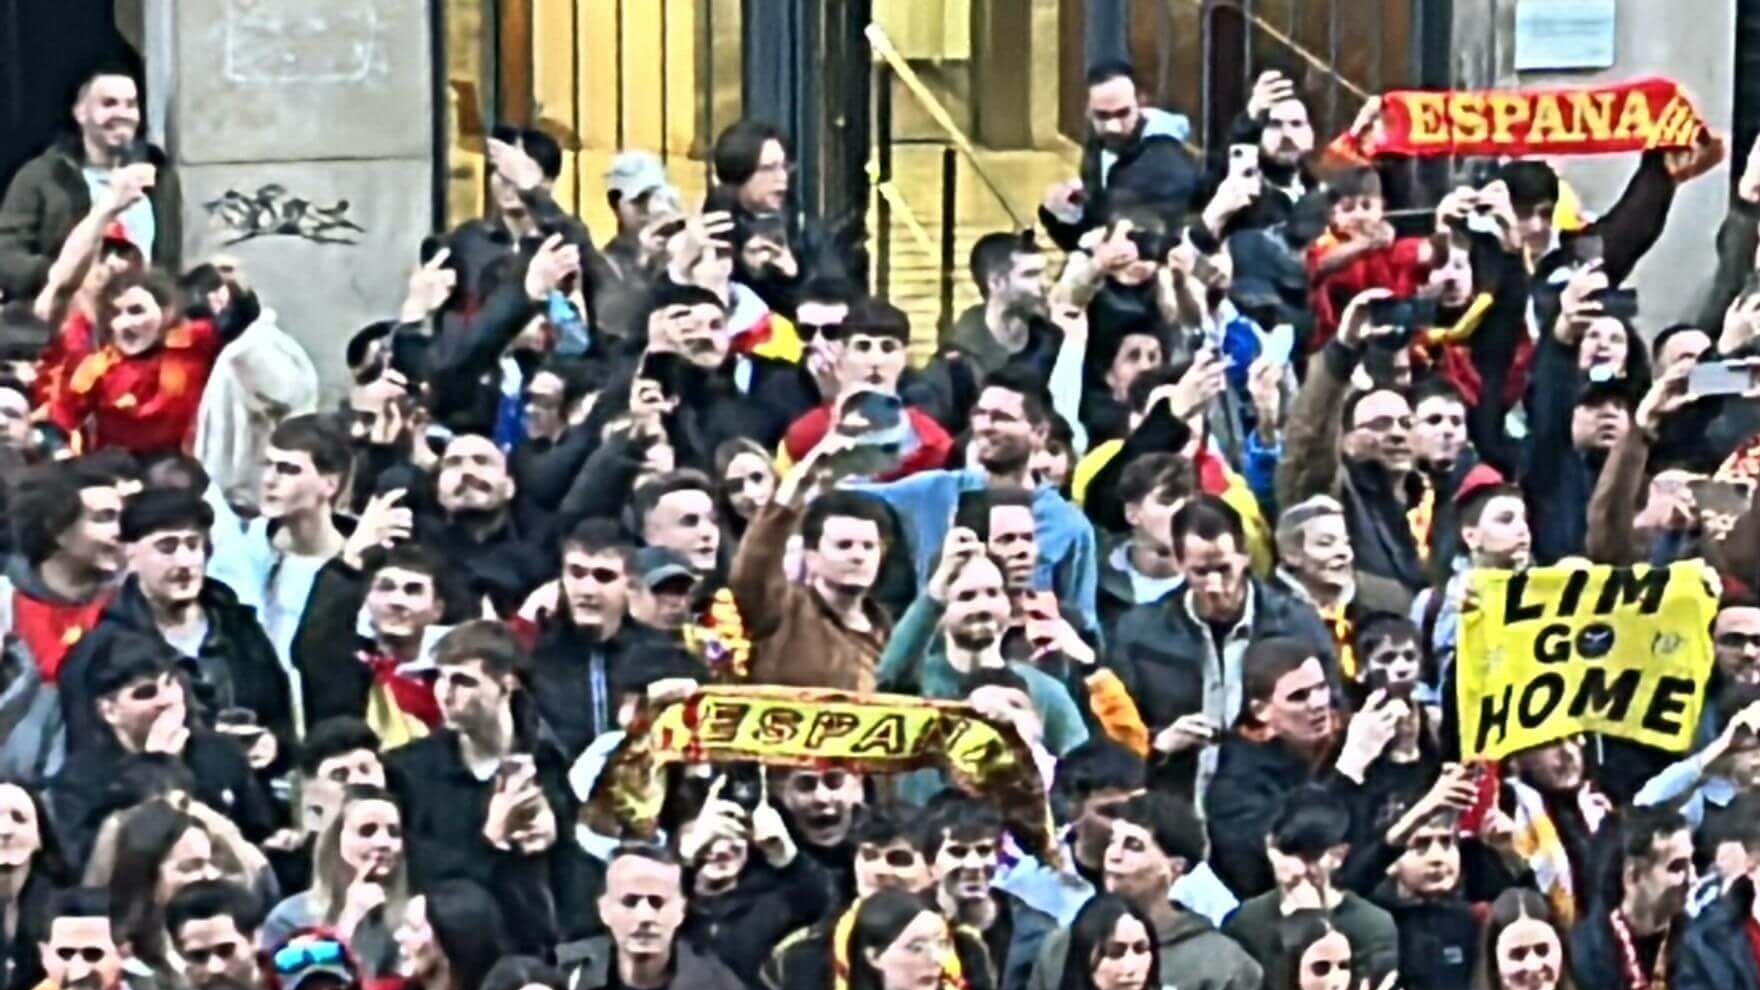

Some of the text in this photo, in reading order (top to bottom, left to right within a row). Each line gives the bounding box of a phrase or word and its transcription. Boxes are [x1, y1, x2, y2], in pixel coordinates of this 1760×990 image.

[1504, 568, 1671, 626] LIM
[1533, 622, 1616, 665] GO
[1475, 666, 1696, 754] HOME
